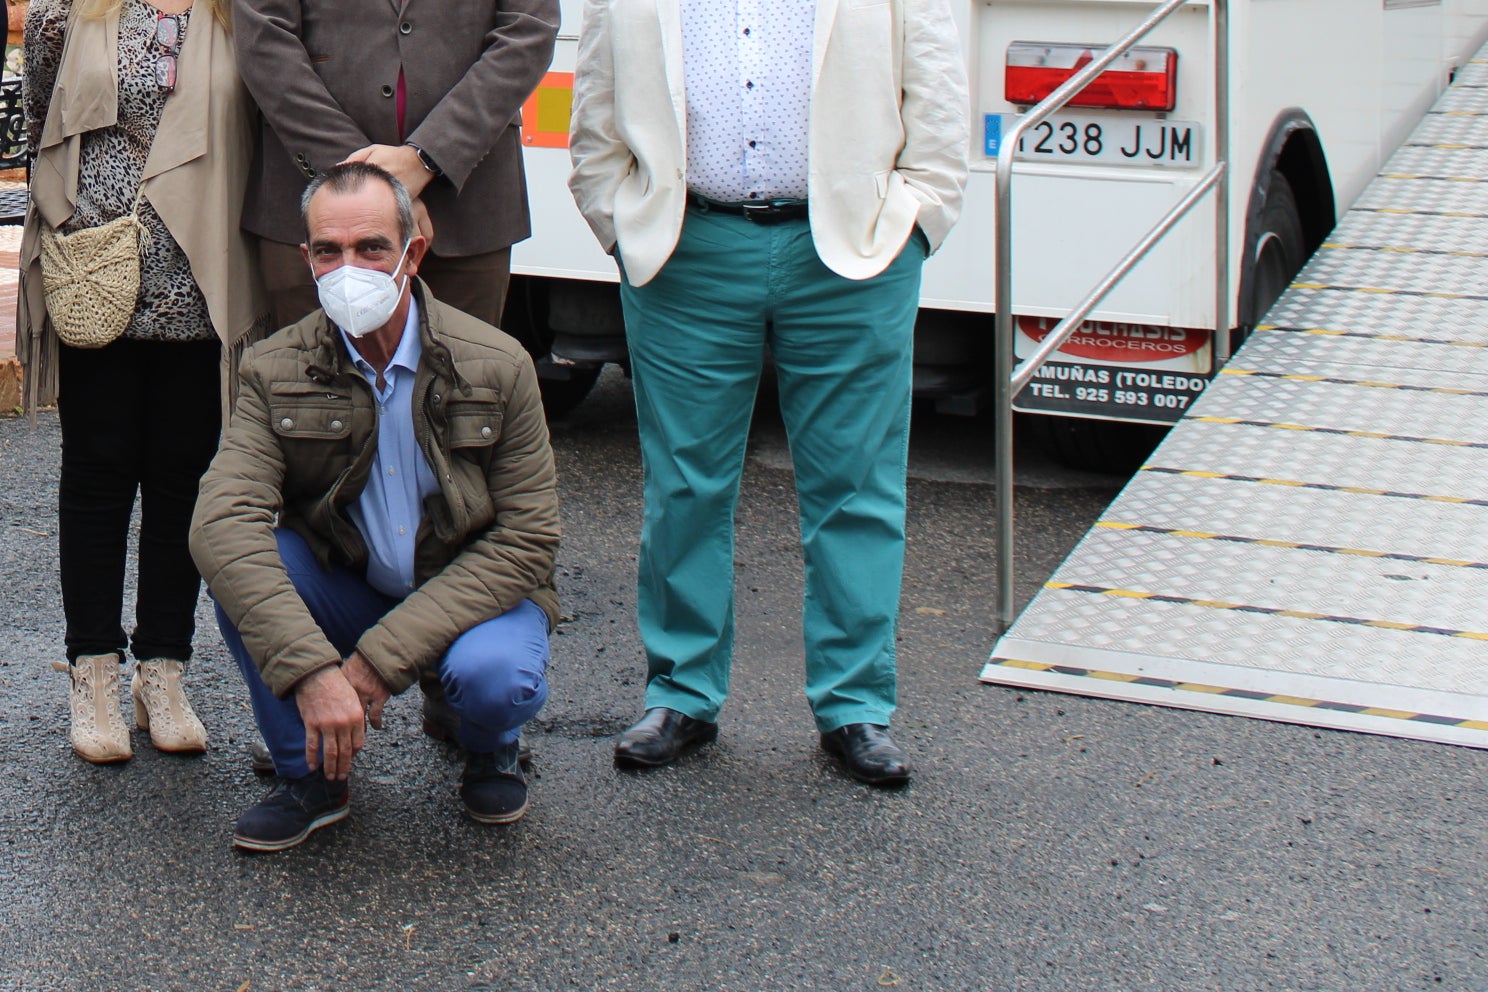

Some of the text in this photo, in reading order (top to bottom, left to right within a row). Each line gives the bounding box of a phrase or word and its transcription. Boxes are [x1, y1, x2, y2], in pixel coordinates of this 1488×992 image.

[1120, 125, 1191, 161] JJM
[1029, 383, 1189, 409] TEL. 925 593 007
